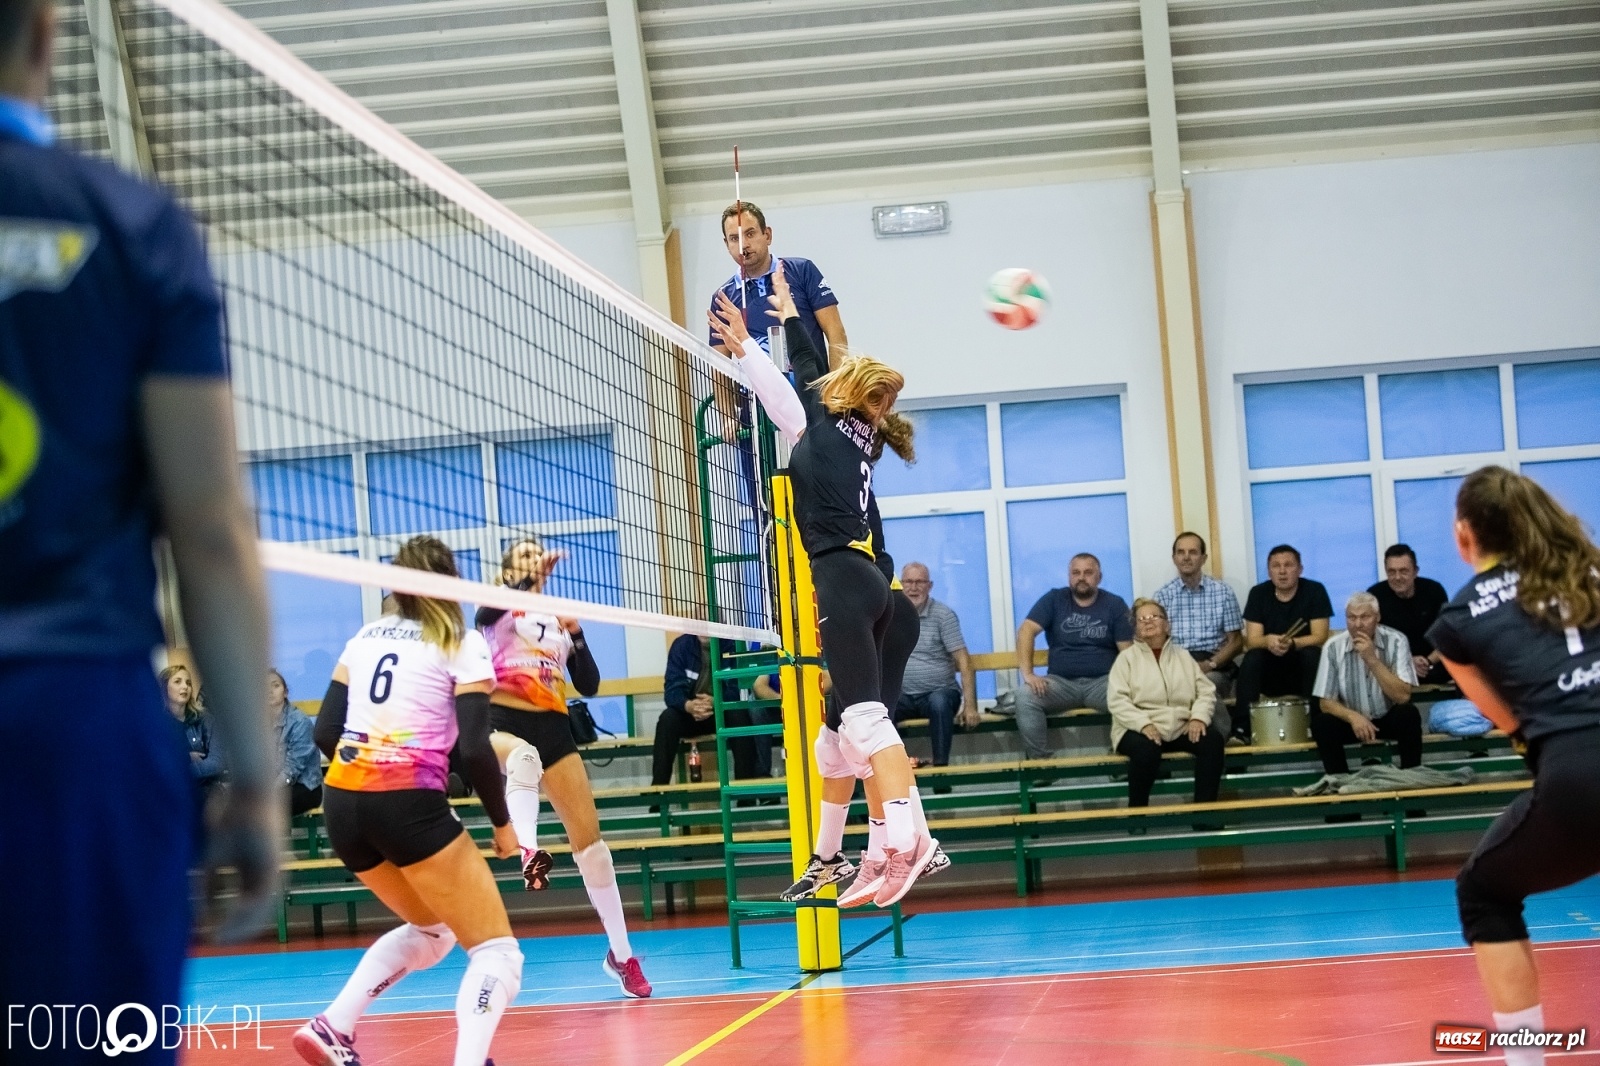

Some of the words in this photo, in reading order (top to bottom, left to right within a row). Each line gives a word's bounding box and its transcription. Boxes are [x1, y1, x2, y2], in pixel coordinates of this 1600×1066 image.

[835, 418, 853, 439] AZS
[852, 432, 866, 450] AWF
[863, 441, 873, 457] KA
[859, 460, 871, 512] 3
[536, 621, 546, 642] 7
[369, 652, 399, 704] 6
